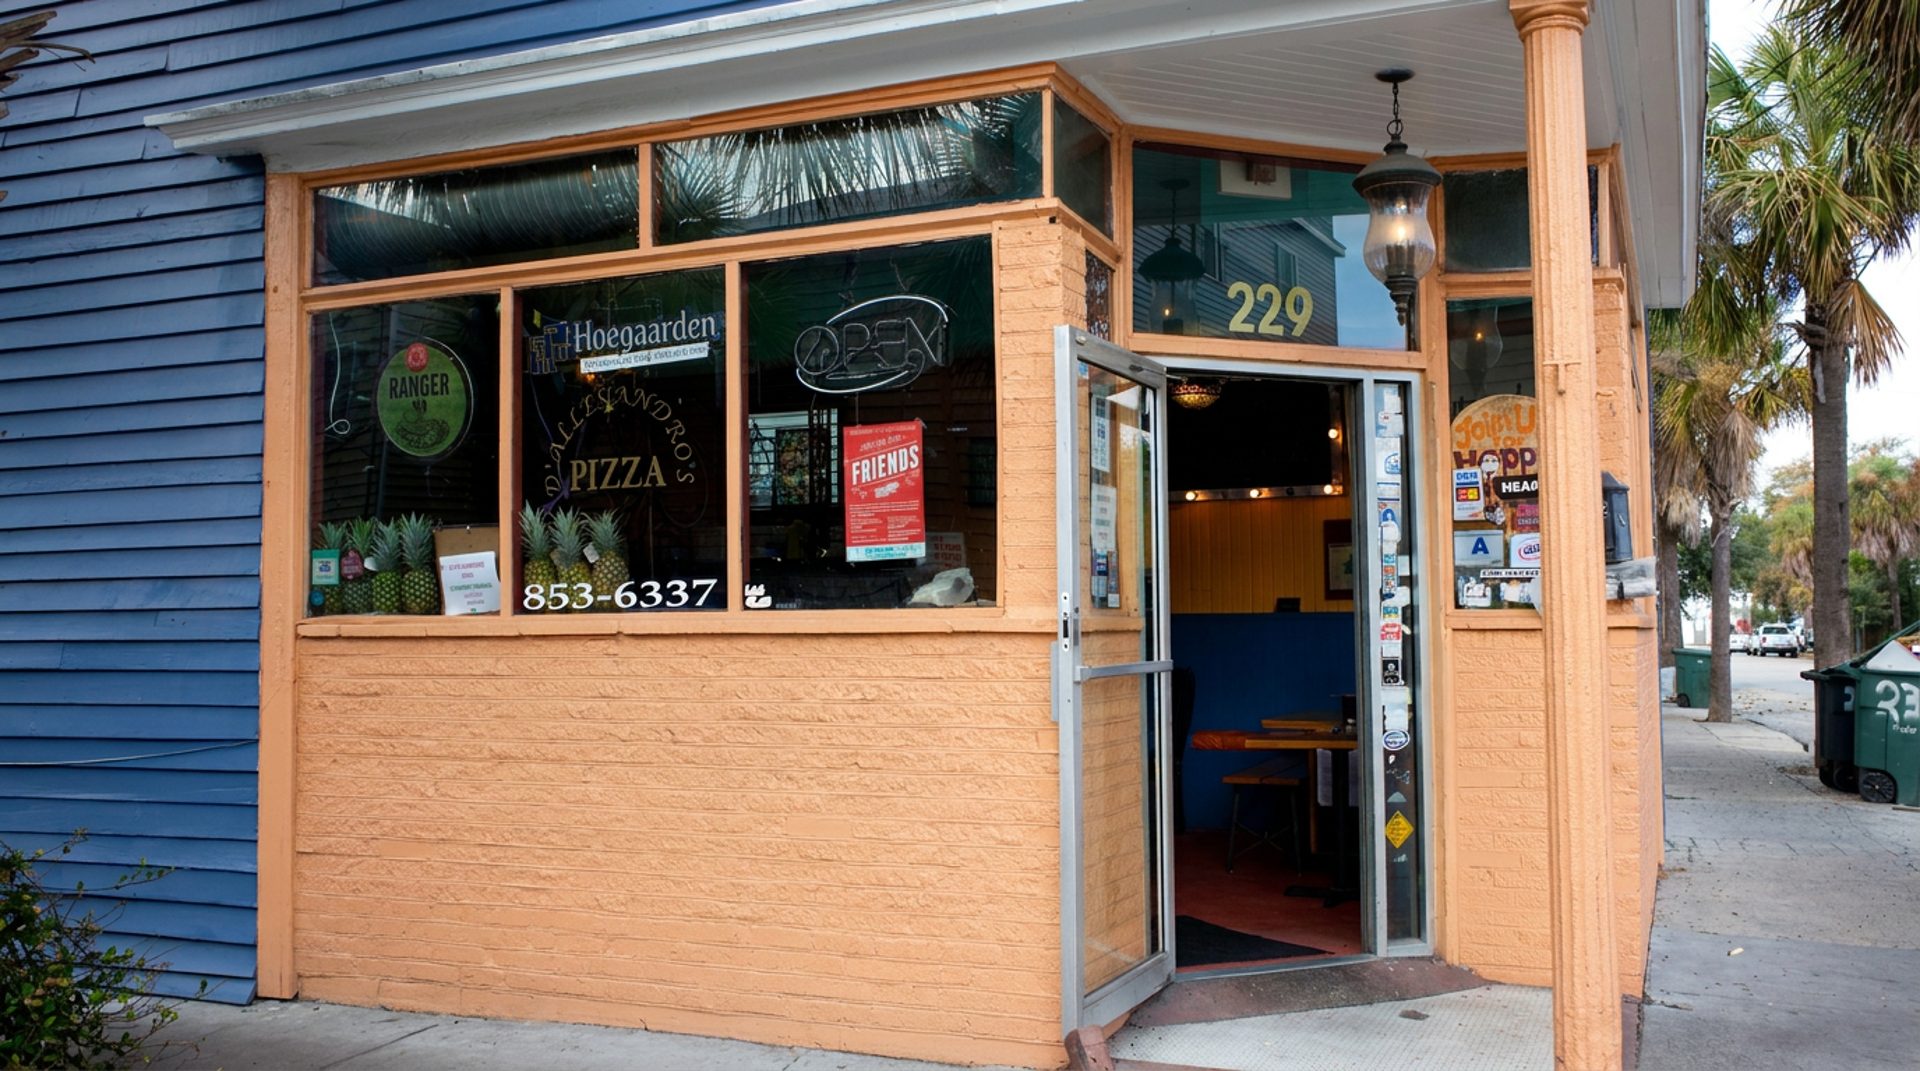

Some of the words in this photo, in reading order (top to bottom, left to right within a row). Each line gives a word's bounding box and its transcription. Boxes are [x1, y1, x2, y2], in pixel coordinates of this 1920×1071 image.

[1227, 281, 1313, 337] 229
[574, 310, 715, 353] Hoegaarden
[389, 372, 450, 400] RANGER
[569, 455, 667, 492] PIZZA
[851, 444, 919, 486] FRIENDS
[1471, 536, 1489, 555] A
[523, 578, 718, 610] 853-6337
